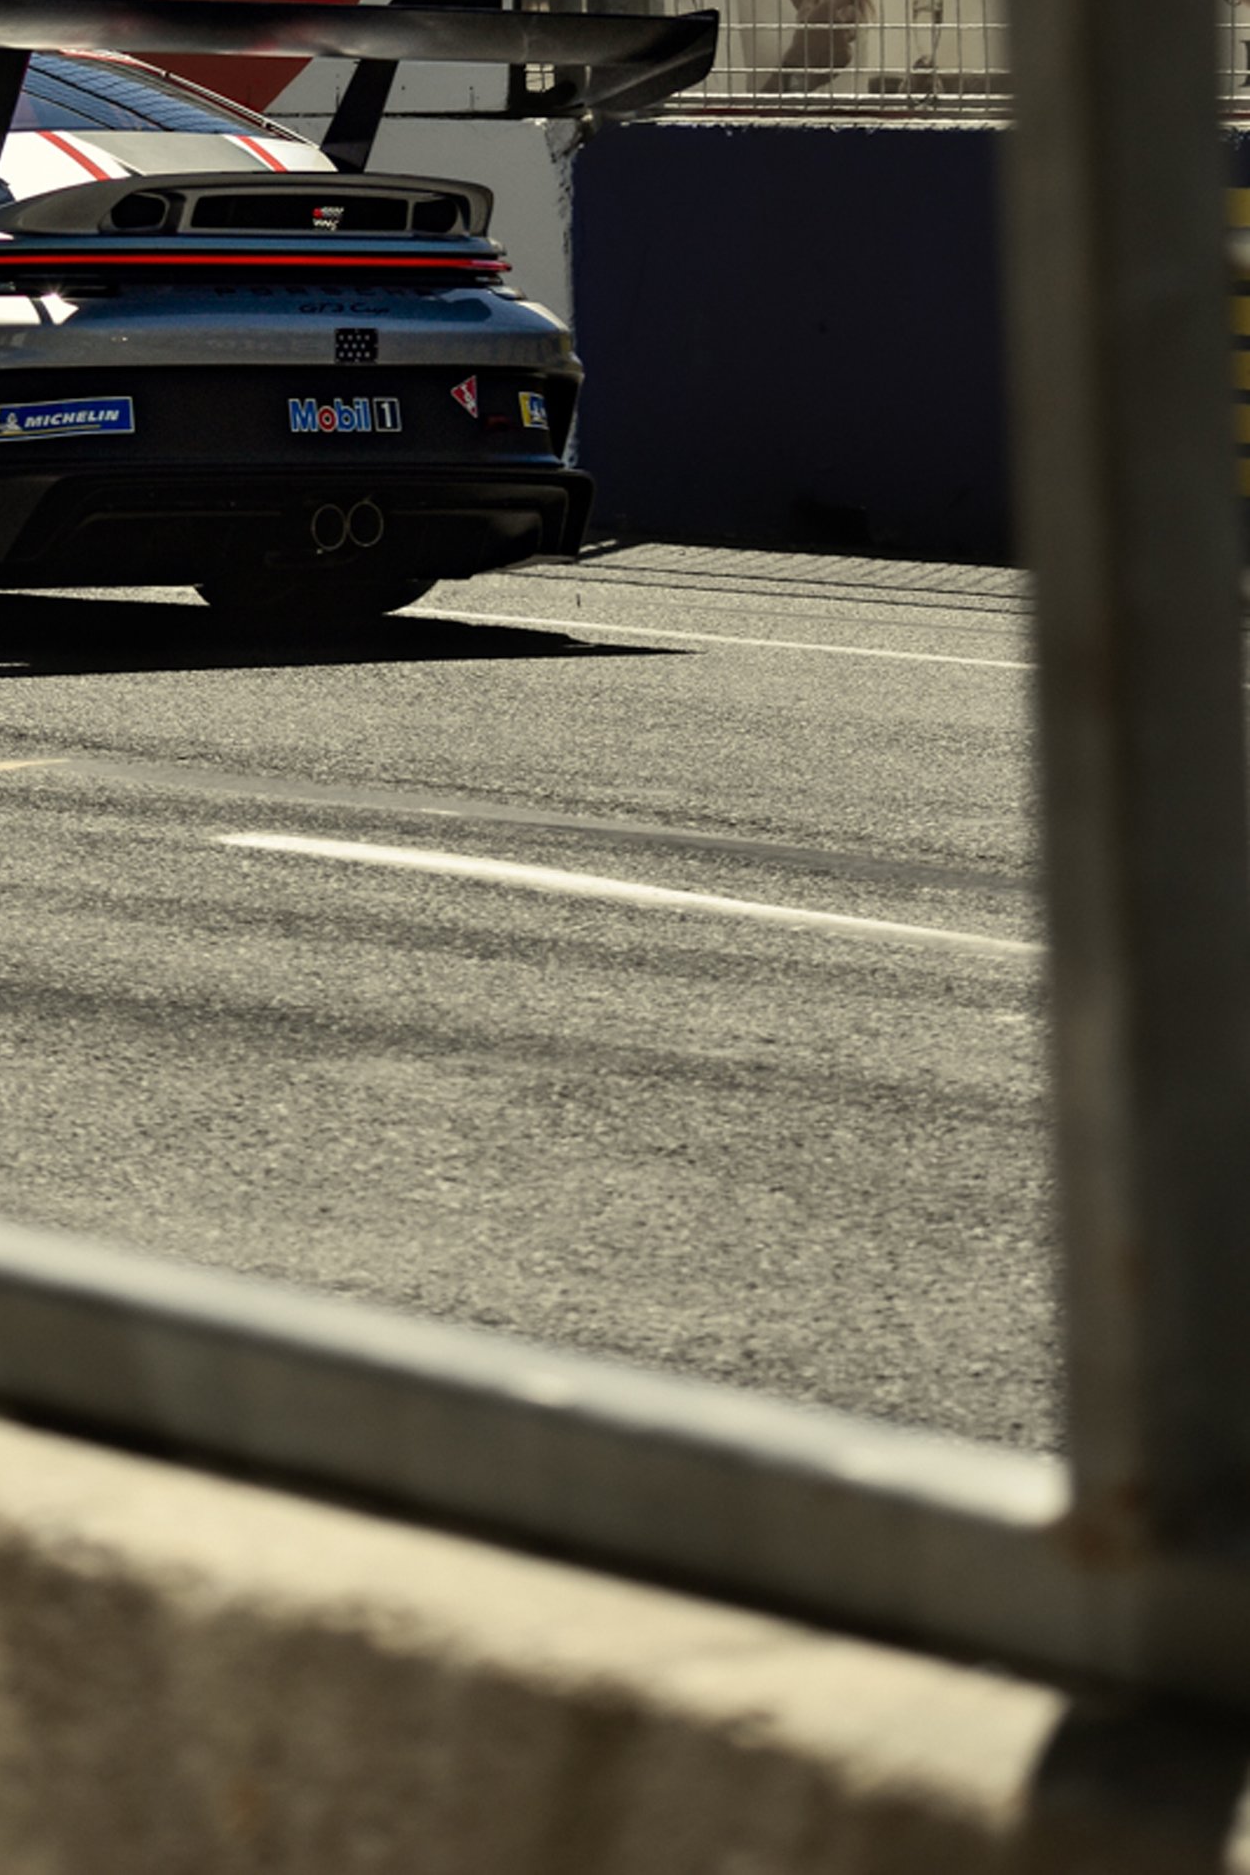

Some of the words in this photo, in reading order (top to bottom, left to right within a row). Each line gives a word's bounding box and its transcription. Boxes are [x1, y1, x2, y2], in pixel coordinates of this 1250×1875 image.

[299, 302, 345, 314] GT3
[350, 301, 391, 316] Cup
[23, 409, 120, 428] MICHELIN
[288, 398, 372, 432] Mobil
